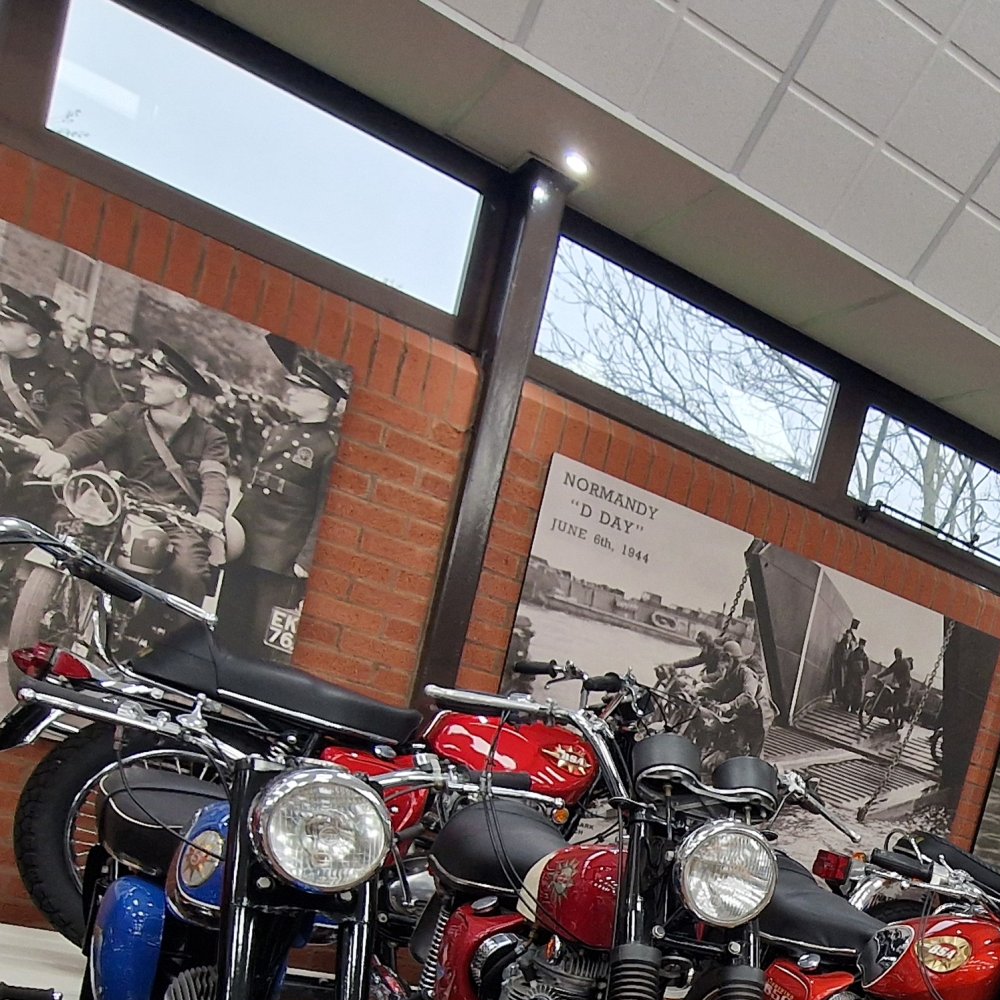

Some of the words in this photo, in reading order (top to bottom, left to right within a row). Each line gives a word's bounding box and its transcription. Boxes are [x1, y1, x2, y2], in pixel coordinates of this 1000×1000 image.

[563, 471, 659, 520] NORMANDY
[550, 518, 588, 540] JUNE
[621, 544, 650, 564] 1944
[928, 944, 957, 960] BSA
